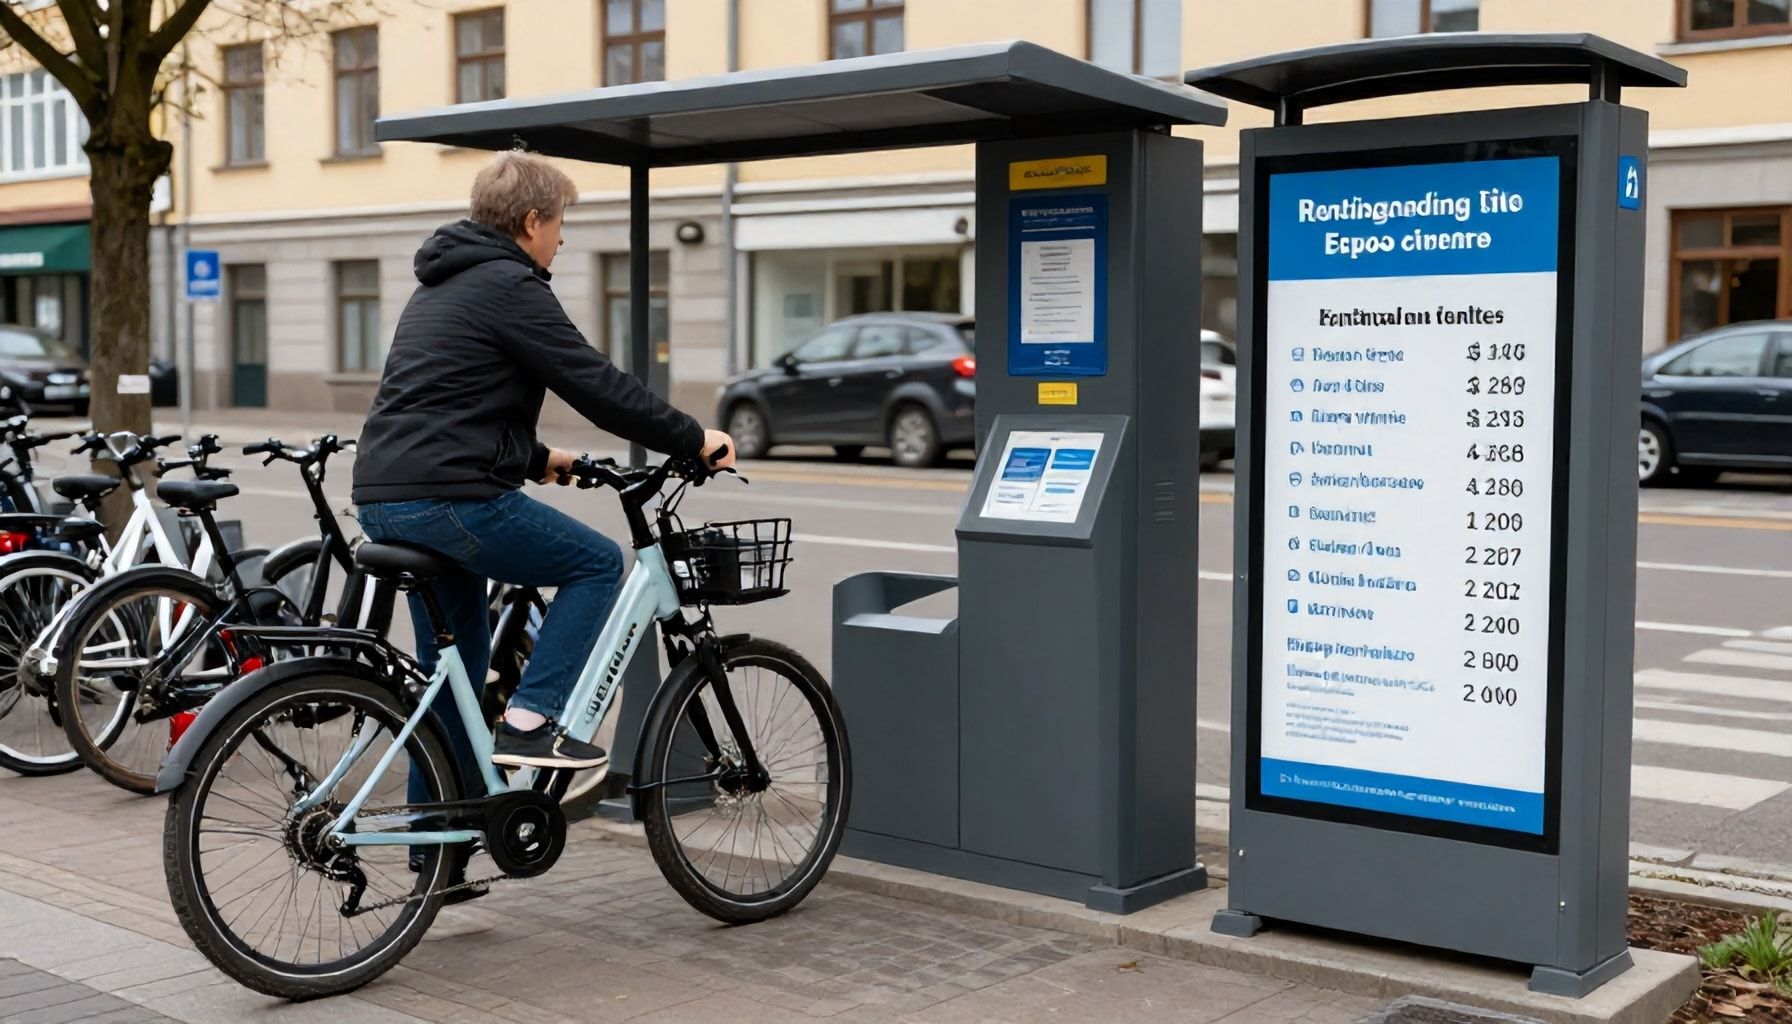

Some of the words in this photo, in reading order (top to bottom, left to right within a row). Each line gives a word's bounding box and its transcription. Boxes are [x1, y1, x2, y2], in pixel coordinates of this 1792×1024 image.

[1467, 511, 1478, 530] 1
[1464, 546, 1478, 564] 2
[1464, 579, 1478, 597] 2
[1464, 613, 1476, 632] 2
[1463, 650, 1476, 668] 2
[1463, 684, 1476, 702] 2
